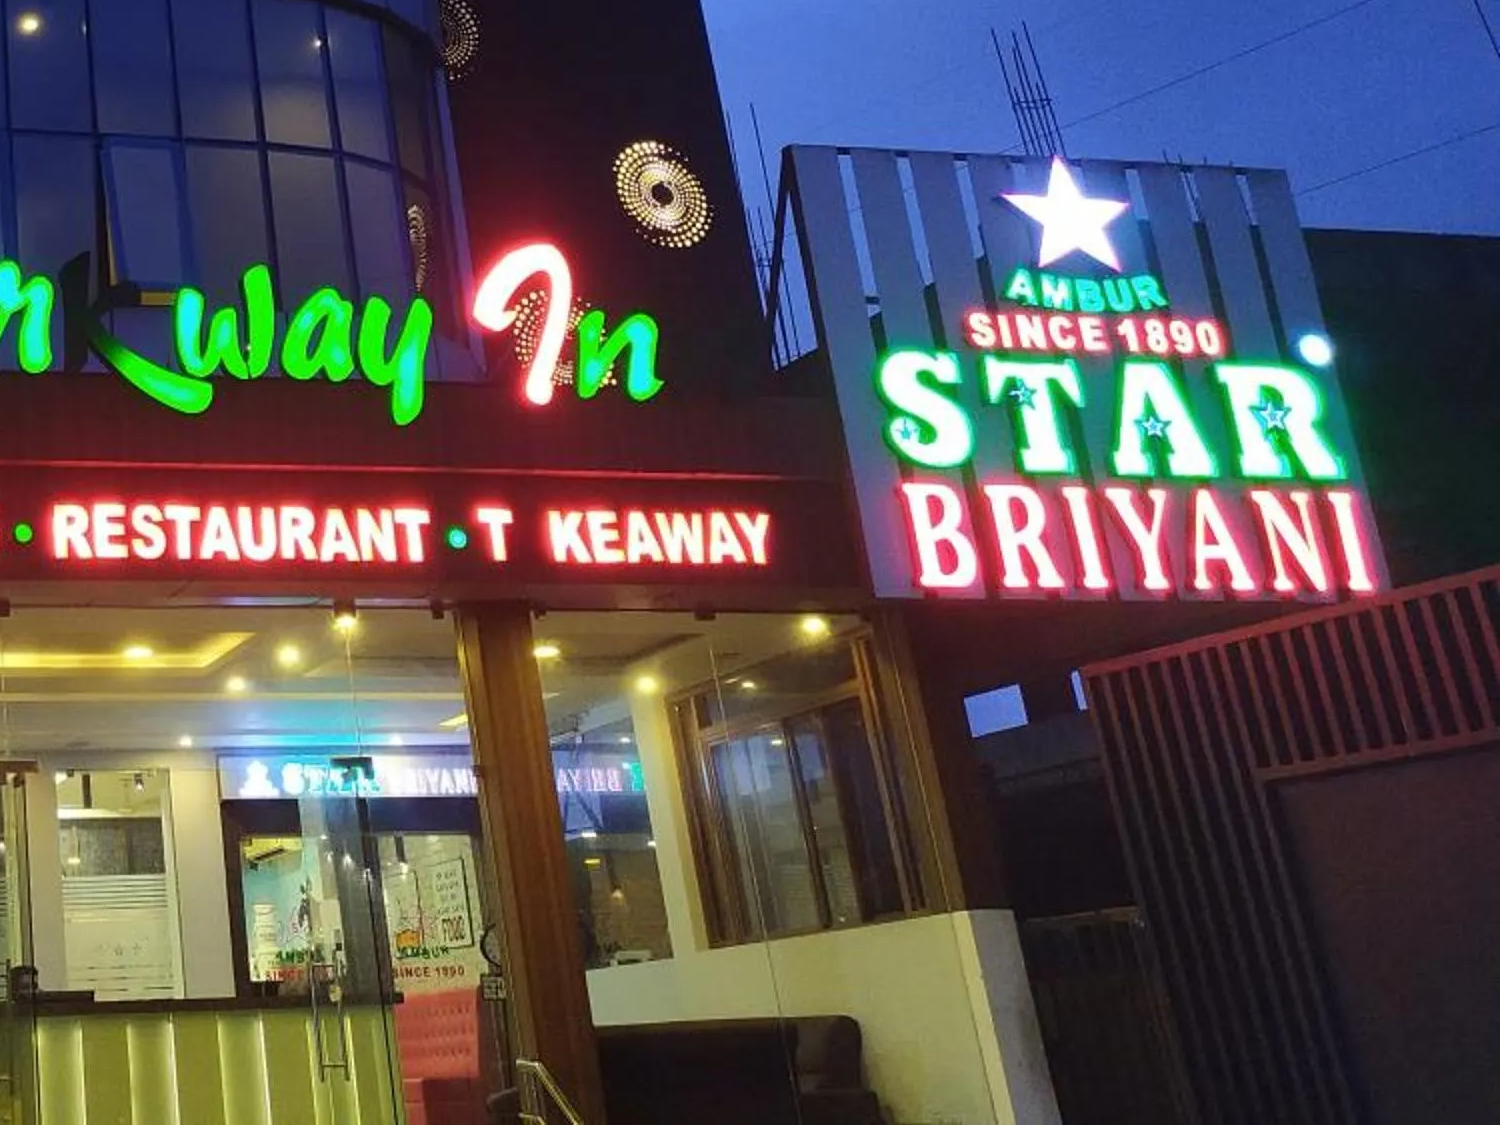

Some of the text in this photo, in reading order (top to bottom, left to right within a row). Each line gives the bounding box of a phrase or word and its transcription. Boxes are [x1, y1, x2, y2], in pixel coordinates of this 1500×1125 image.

[473, 242, 663, 403] In
[1005, 268, 1169, 312] AMBUR
[968, 312, 1222, 355] SINCE 1890
[877, 349, 1348, 480] STAR
[53, 504, 430, 563] RESTAURANT
[901, 482, 1373, 593] BRIYANI
